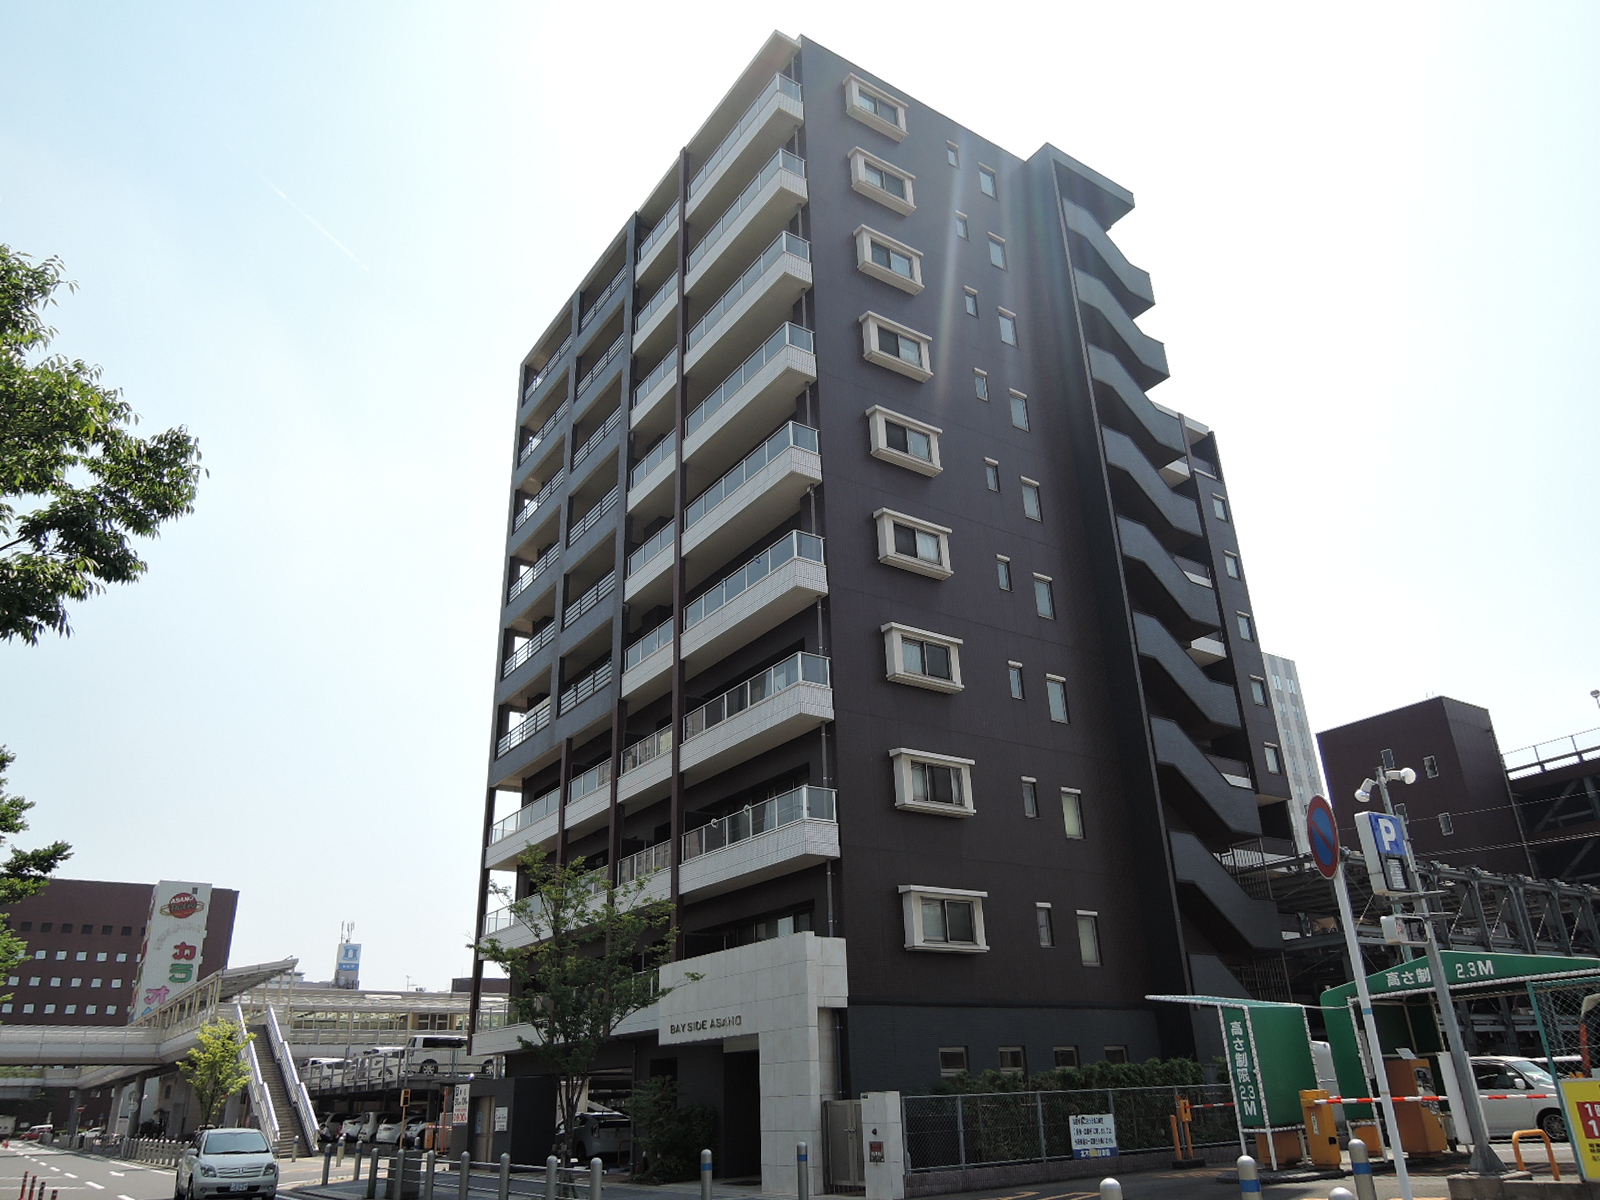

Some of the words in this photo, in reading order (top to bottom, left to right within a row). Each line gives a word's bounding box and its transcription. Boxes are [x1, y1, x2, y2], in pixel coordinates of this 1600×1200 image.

[1378, 818, 1397, 851] P
[1455, 959, 1495, 979] 2.3M
[709, 1015, 742, 1028] ASANO
